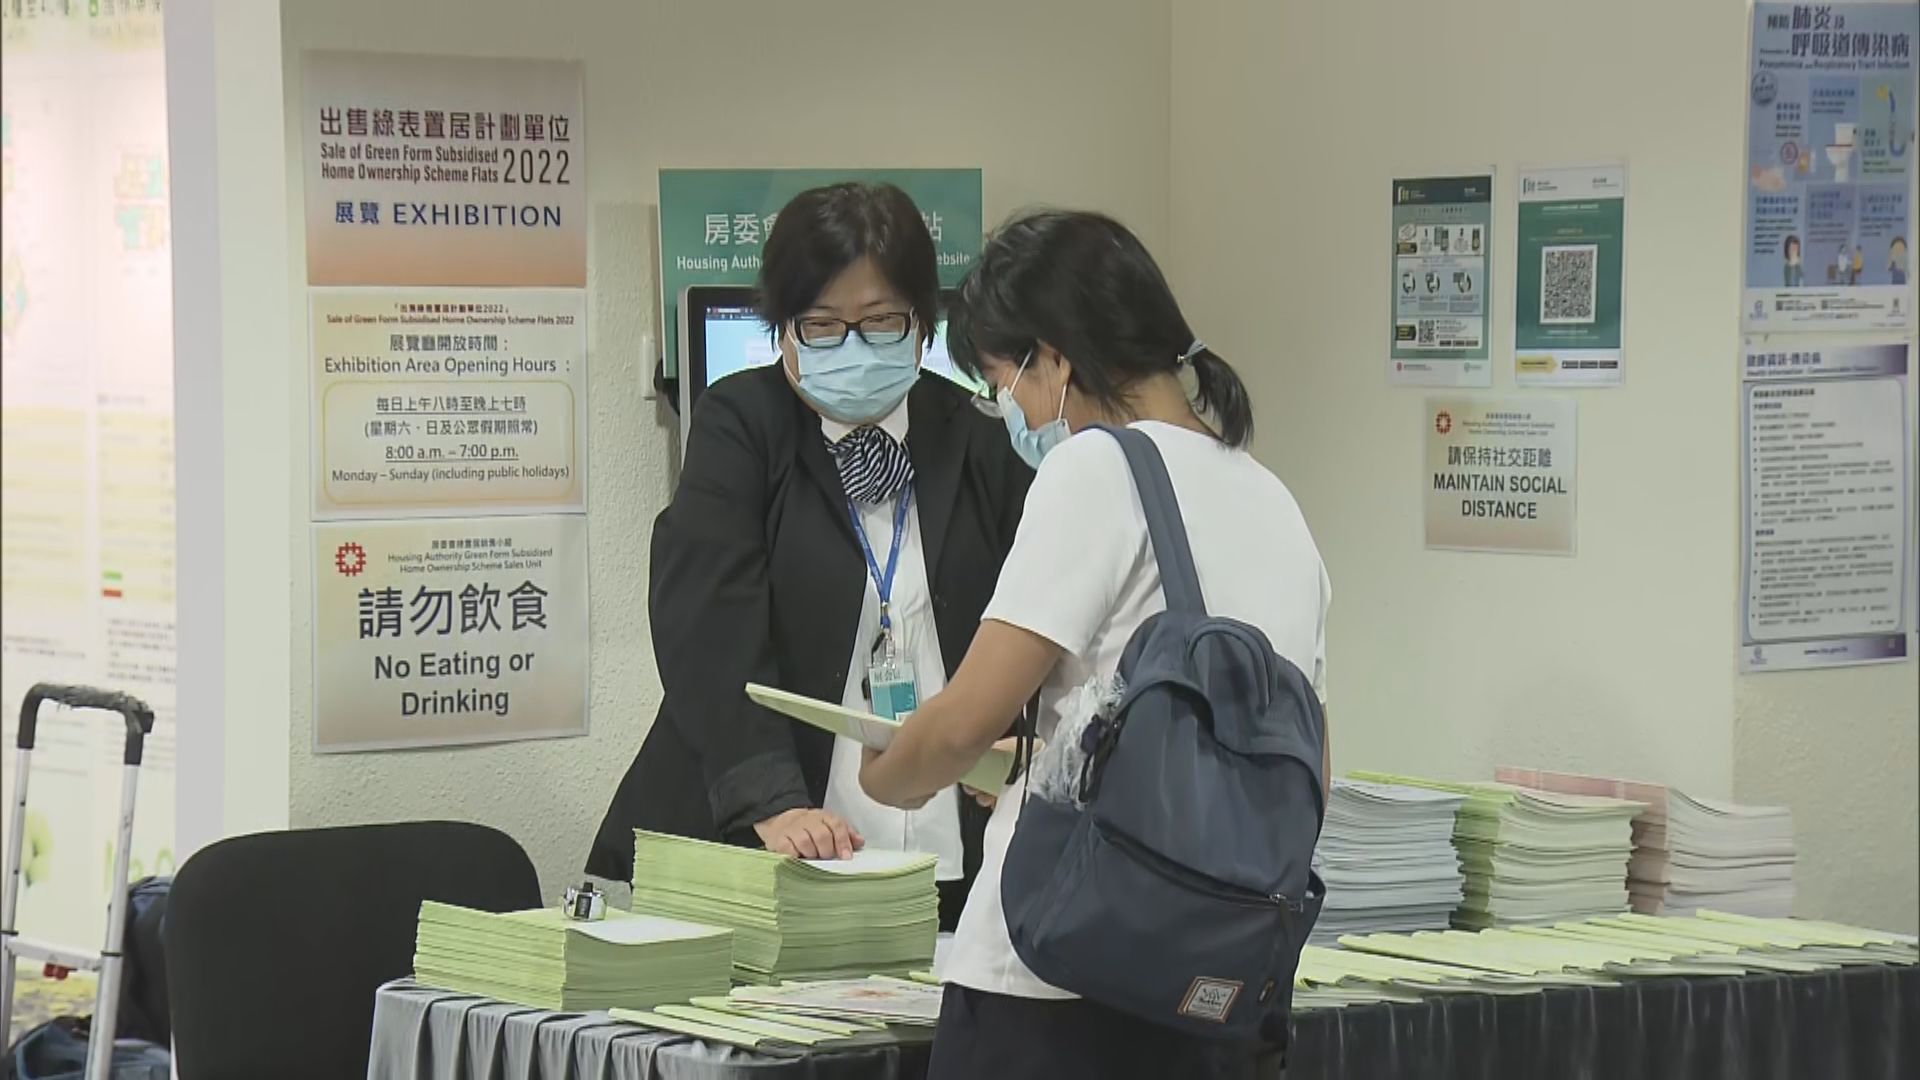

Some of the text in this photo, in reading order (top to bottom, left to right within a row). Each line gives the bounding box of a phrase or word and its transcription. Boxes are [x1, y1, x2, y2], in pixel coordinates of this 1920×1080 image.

[1792, 33, 1910, 57] 呼吸道傳染病
[320, 107, 571, 142] 出售綠表置居計劃單位
[320, 142, 498, 163] Sale of Green Form Subsidised
[321, 164, 498, 184] Home Ownership Scheme Flats
[503, 148, 570, 185] 2022
[335, 202, 561, 227] 展覽 EXHIBITION
[677, 255, 728, 272] Housing
[327, 315, 574, 326] Sale of Green Form Subsidised Home Ownership Scheme Flats 2022
[325, 358, 401, 374] Exhibition
[405, 358, 439, 373] Area
[444, 358, 508, 376] Opening
[513, 358, 556, 372] Hours
[376, 396, 526, 412] 每日上午八時至晚上七時
[385, 446, 414, 459] 8:00
[417, 448, 445, 459] a.m.
[460, 444, 487, 458] 7:00
[490, 447, 519, 460] p.m.
[1448, 446, 1552, 468] 請保持社交距離
[332, 469, 377, 484] Monday
[390, 468, 429, 483] Sunday
[431, 467, 485, 481] (including
[487, 466, 520, 480] public
[522, 465, 569, 479] holidays)
[1434, 474, 1567, 494] MAINTAIN SOCIAL
[1462, 500, 1537, 519] DISTANCE
[388, 548, 553, 563] Housing Authority Green Form Subsidised
[400, 559, 542, 574] Home Ownership Scheme Sales Unit
[358, 580, 548, 639] 請勿飲食
[374, 651, 534, 679] No Eating or
[402, 689, 509, 716] Drinking
